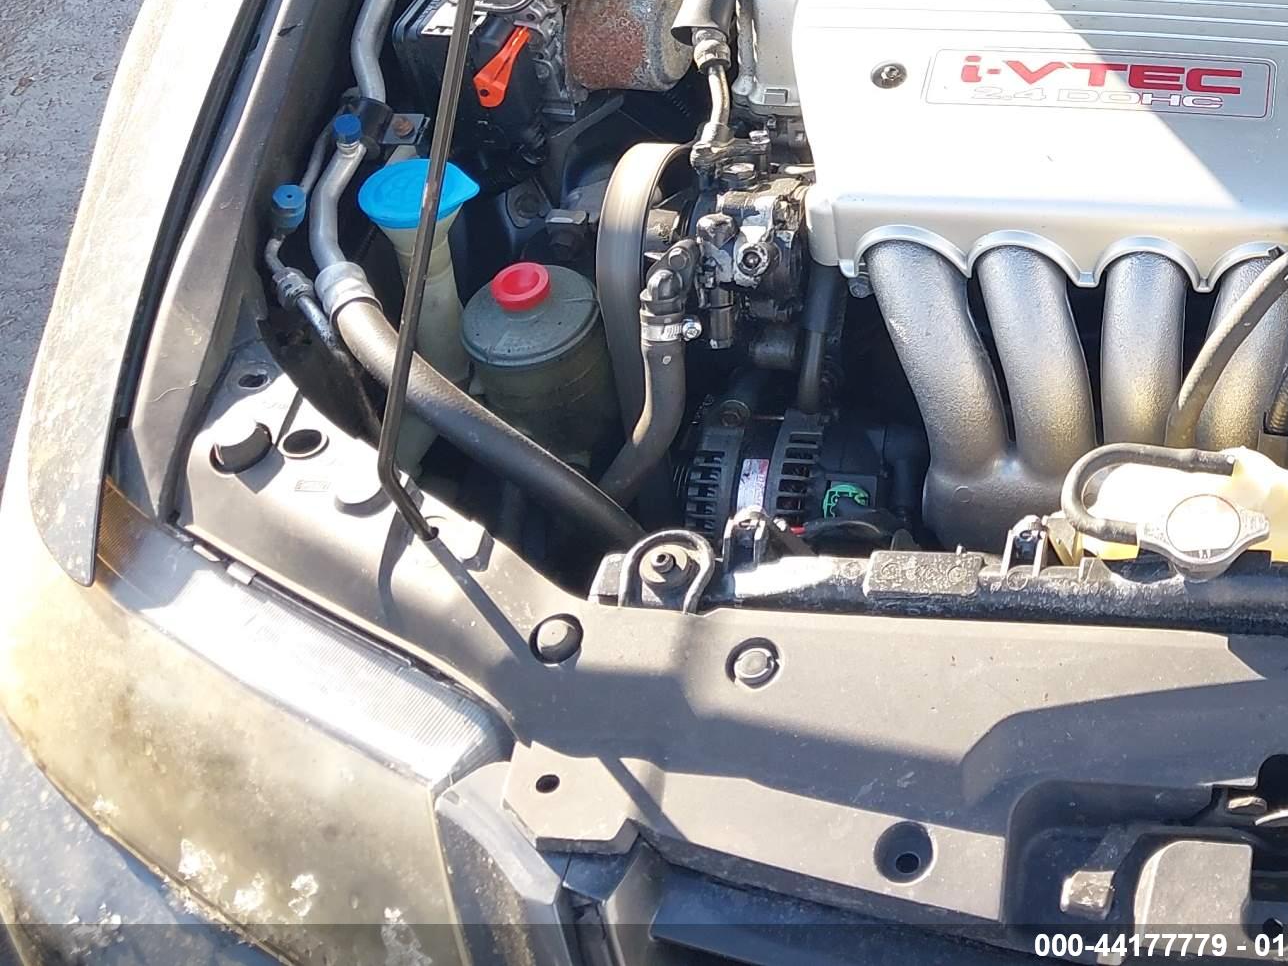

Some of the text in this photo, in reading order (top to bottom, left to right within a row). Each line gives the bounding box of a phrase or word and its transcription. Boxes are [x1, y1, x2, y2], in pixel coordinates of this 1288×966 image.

[961, 55, 1242, 94] i-VTEC
[973, 86, 1224, 109] 2.4 DOHC
